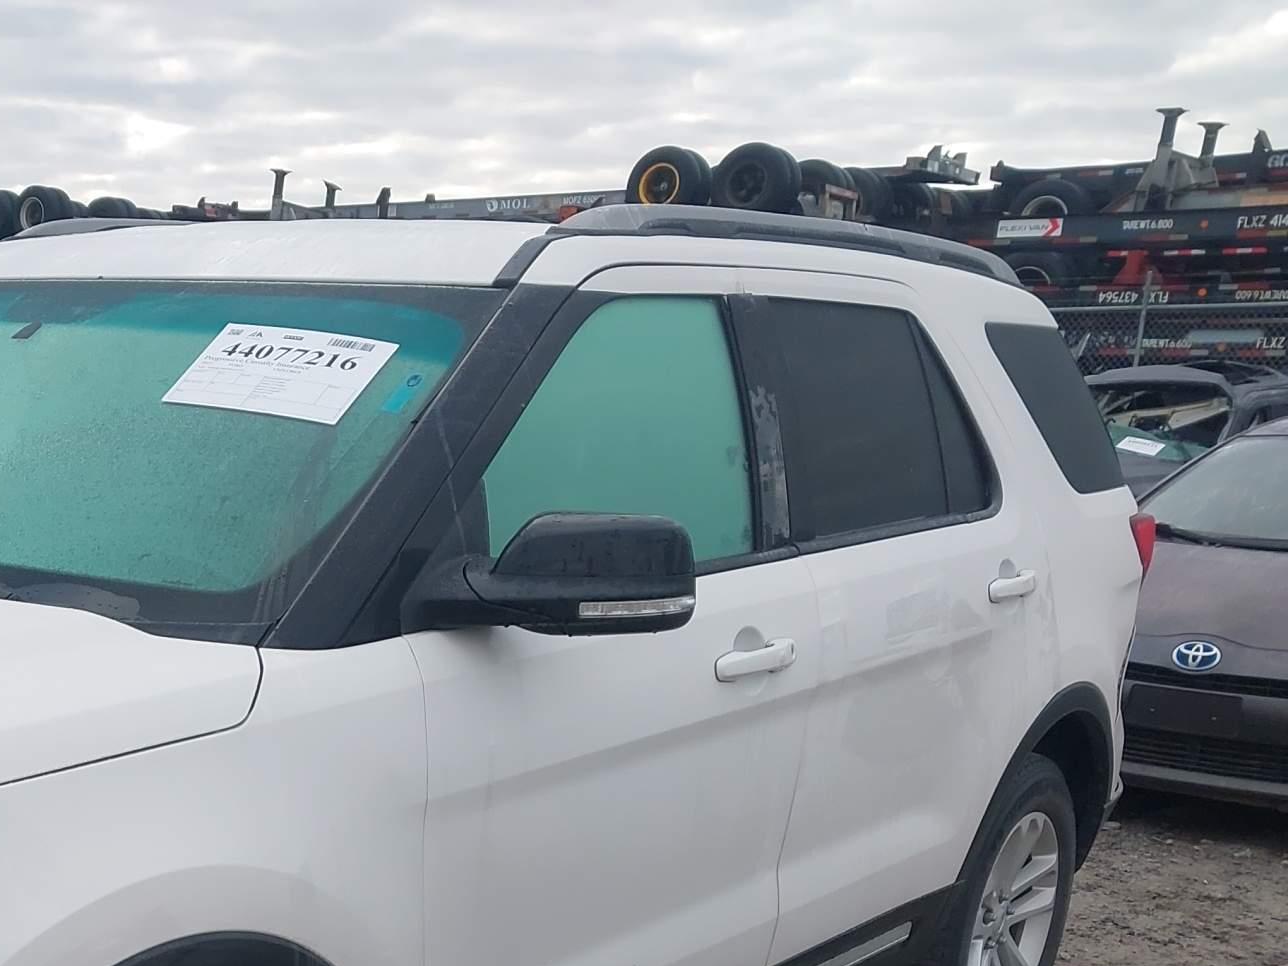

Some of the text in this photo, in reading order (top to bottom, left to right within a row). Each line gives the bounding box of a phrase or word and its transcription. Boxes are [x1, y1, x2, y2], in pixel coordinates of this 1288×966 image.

[500, 198, 530, 209] MOL
[1237, 214, 1267, 229] FLXZ
[1098, 291, 1139, 304] 437564
[1256, 336, 1286, 349] FLXZ
[222, 341, 362, 371] 44077216
